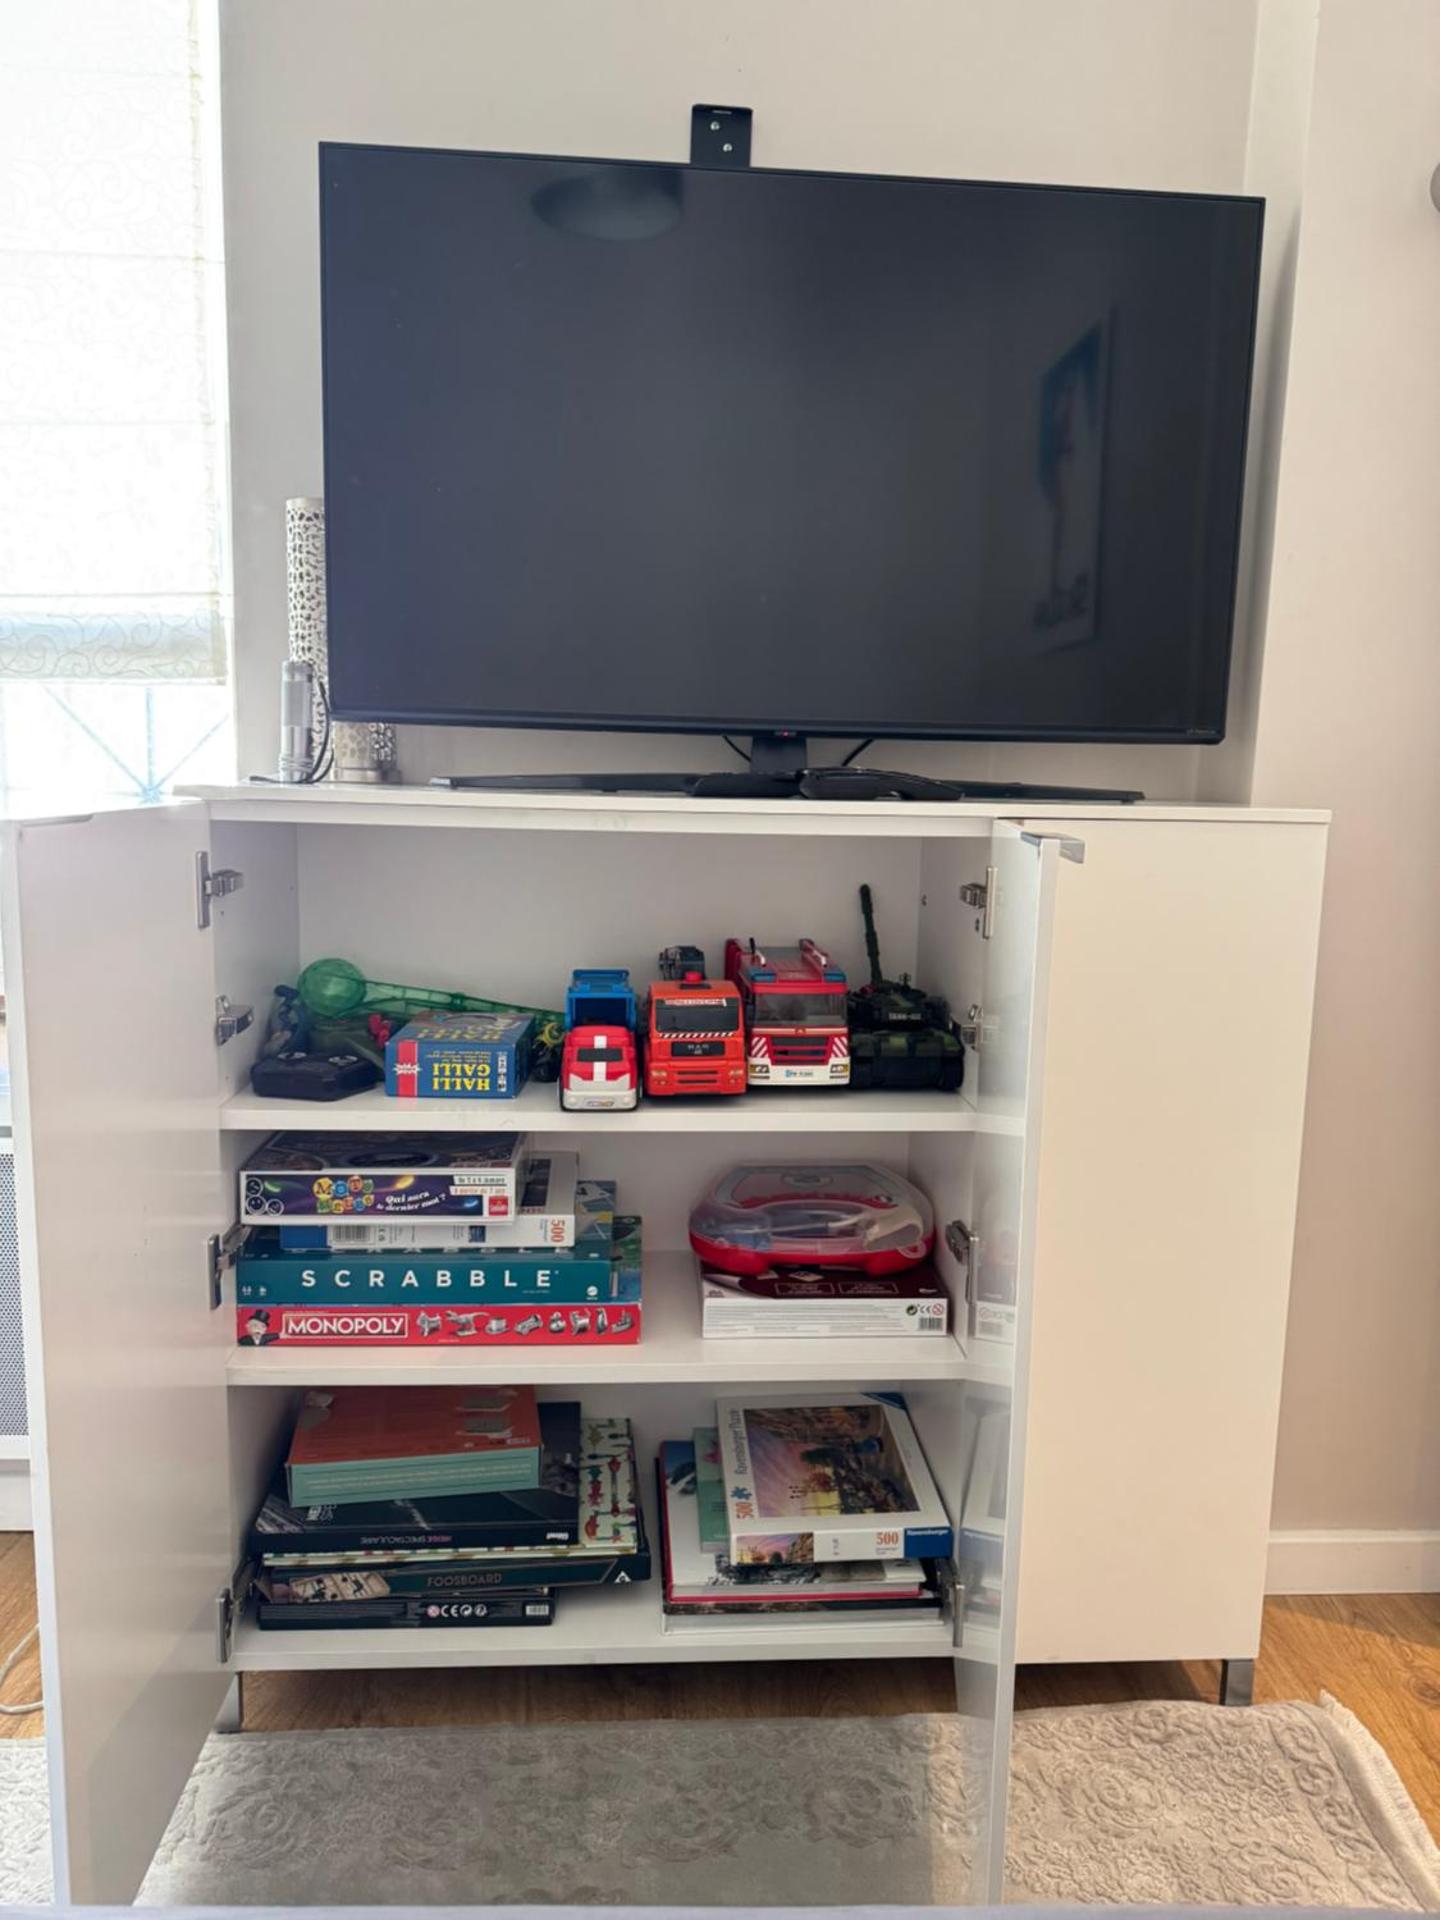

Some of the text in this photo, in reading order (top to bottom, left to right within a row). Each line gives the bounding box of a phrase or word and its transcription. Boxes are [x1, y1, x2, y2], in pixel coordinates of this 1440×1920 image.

[432, 1063, 491, 1077] GALLI
[432, 1077, 491, 1091] HALLI
[550, 1219, 566, 1243] 500
[301, 1269, 551, 1288] SCRABBLE
[287, 1317, 405, 1335] MONOPOLY
[875, 1531, 899, 1545] 500
[426, 1573, 503, 1587] FOOSBOARD
